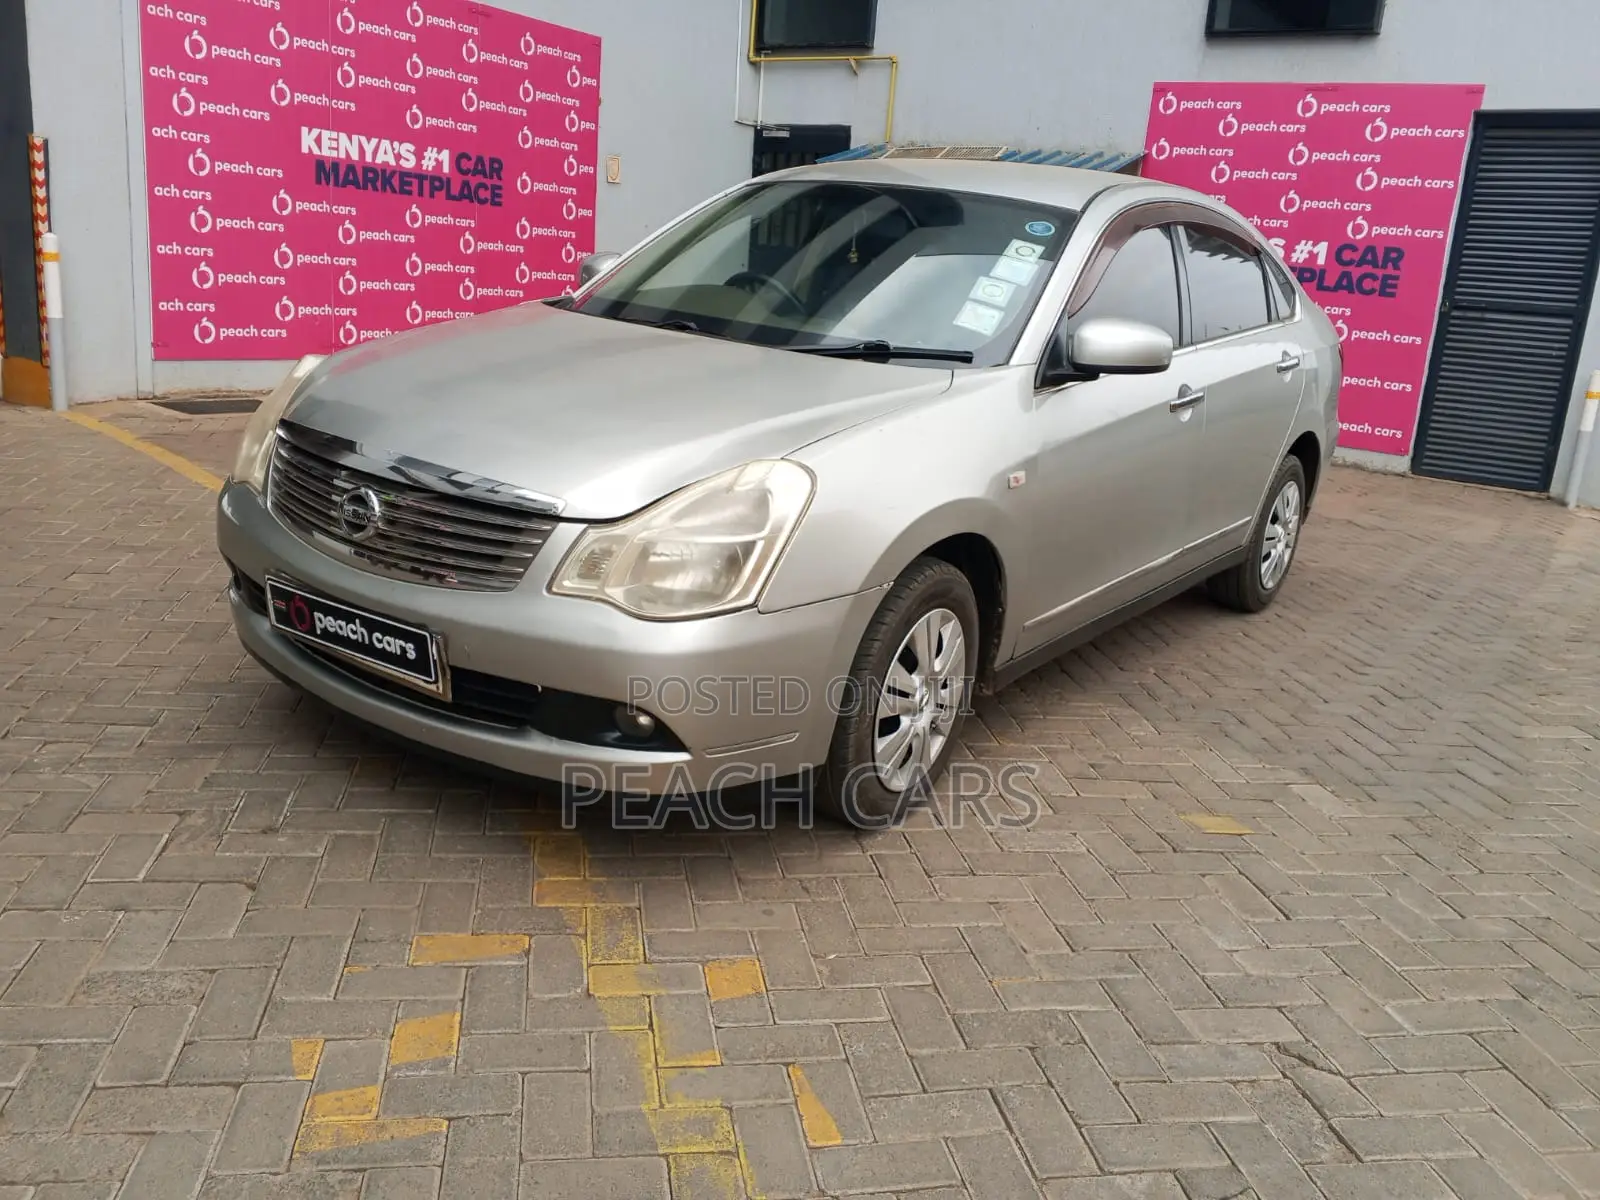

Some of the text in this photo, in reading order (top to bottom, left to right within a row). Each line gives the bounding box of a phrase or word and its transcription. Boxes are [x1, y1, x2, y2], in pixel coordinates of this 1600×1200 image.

[176, 9, 207, 26] cars
[358, 21, 416, 42] peach cars
[427, 15, 478, 35] peach cars
[293, 36, 356, 58] peach cars
[537, 43, 581, 62] peach cars
[212, 45, 281, 67] peach cars
[480, 50, 528, 70] peach cars
[178, 72, 208, 86] cars
[426, 65, 478, 84] peach cars
[358, 75, 416, 94] peach cars
[294, 92, 356, 112] peach cars
[536, 90, 580, 107] peach cars
[1180, 98, 1242, 111] peach cars
[200, 102, 270, 121] peach cars
[479, 99, 527, 117] peach cars
[1321, 101, 1390, 115] peach cars
[426, 115, 477, 133] peach cars
[1241, 121, 1306, 134] peach cars
[181, 132, 210, 144] cars
[1390, 125, 1465, 139] peach cars
[535, 136, 578, 152] peach cars
[1173, 144, 1234, 158] peach cars
[300, 126, 503, 180] KENYA'S #1 CAR
[1312, 150, 1381, 164] peach cars
[215, 161, 283, 178] peach cars
[1233, 168, 1297, 180] peach cars
[315, 159, 503, 206] MARKETPLACE
[533, 181, 576, 195] peach cars
[1381, 175, 1454, 189] peach cars
[183, 190, 211, 200] cars
[296, 201, 356, 216] peach cars
[1303, 198, 1371, 212] peach cars
[216, 217, 284, 232] peach cars
[425, 214, 475, 228] peach cars
[1263, 219, 1288, 228] cars
[360, 230, 415, 243] peach cars
[532, 226, 575, 239] peach cars
[1372, 226, 1444, 239] peach cars
[185, 246, 213, 257] cars
[478, 240, 524, 253] peach cars
[297, 253, 357, 266] peach cars
[1291, 239, 1328, 265] #1
[1334, 244, 1404, 271] CAR
[425, 262, 474, 274] peach cars
[532, 269, 574, 281] peach cars
[218, 272, 285, 286] peach cars
[360, 280, 415, 292] peach cars
[477, 286, 523, 298] peach cars
[187, 302, 215, 312] cars
[298, 304, 357, 318] peach cars
[1324, 305, 1351, 316] cars
[425, 309, 453, 321] peach
[220, 326, 287, 340] peach cars
[1351, 329, 1422, 345] peach cars
[1342, 375, 1412, 392] peach cars
[1374, 428, 1402, 438] cars
[314, 612, 416, 660] peach cars
